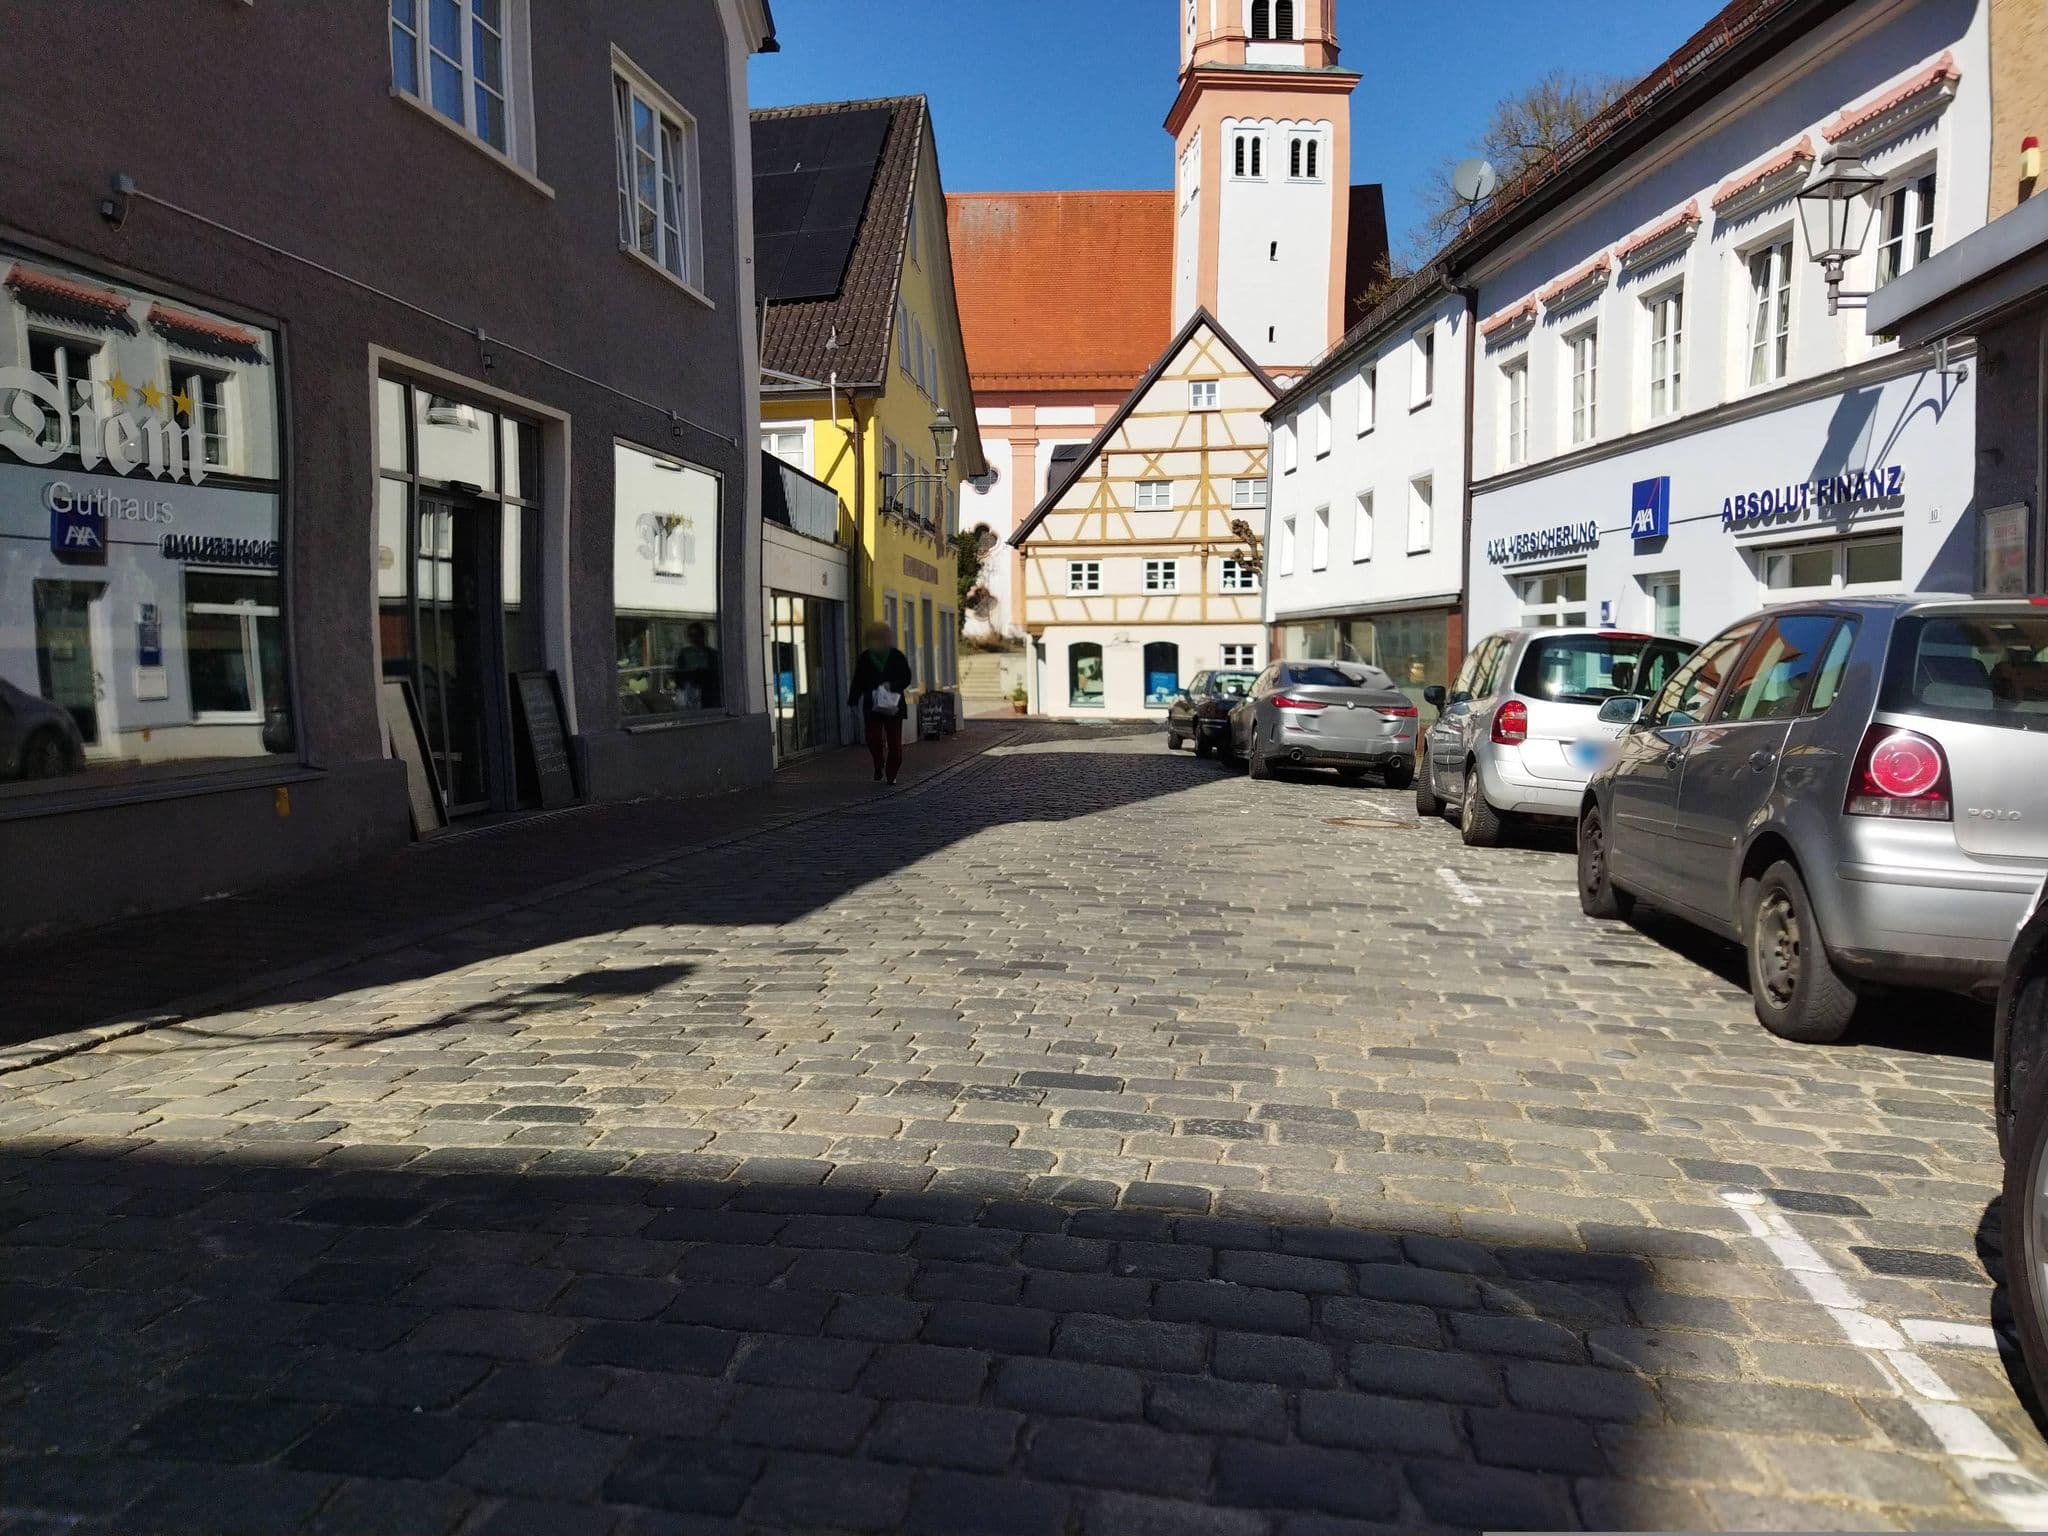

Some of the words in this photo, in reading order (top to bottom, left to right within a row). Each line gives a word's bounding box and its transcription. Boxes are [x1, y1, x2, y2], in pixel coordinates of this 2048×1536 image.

[49, 481, 174, 524] Guthaus
[1722, 482, 1810, 522] ABSOLUT
[1817, 465, 1902, 507] FINANZ
[1509, 520, 1597, 555] VERSICHERUNG
[1632, 508, 1655, 533] AXA
[1967, 807, 2022, 821] POLO
